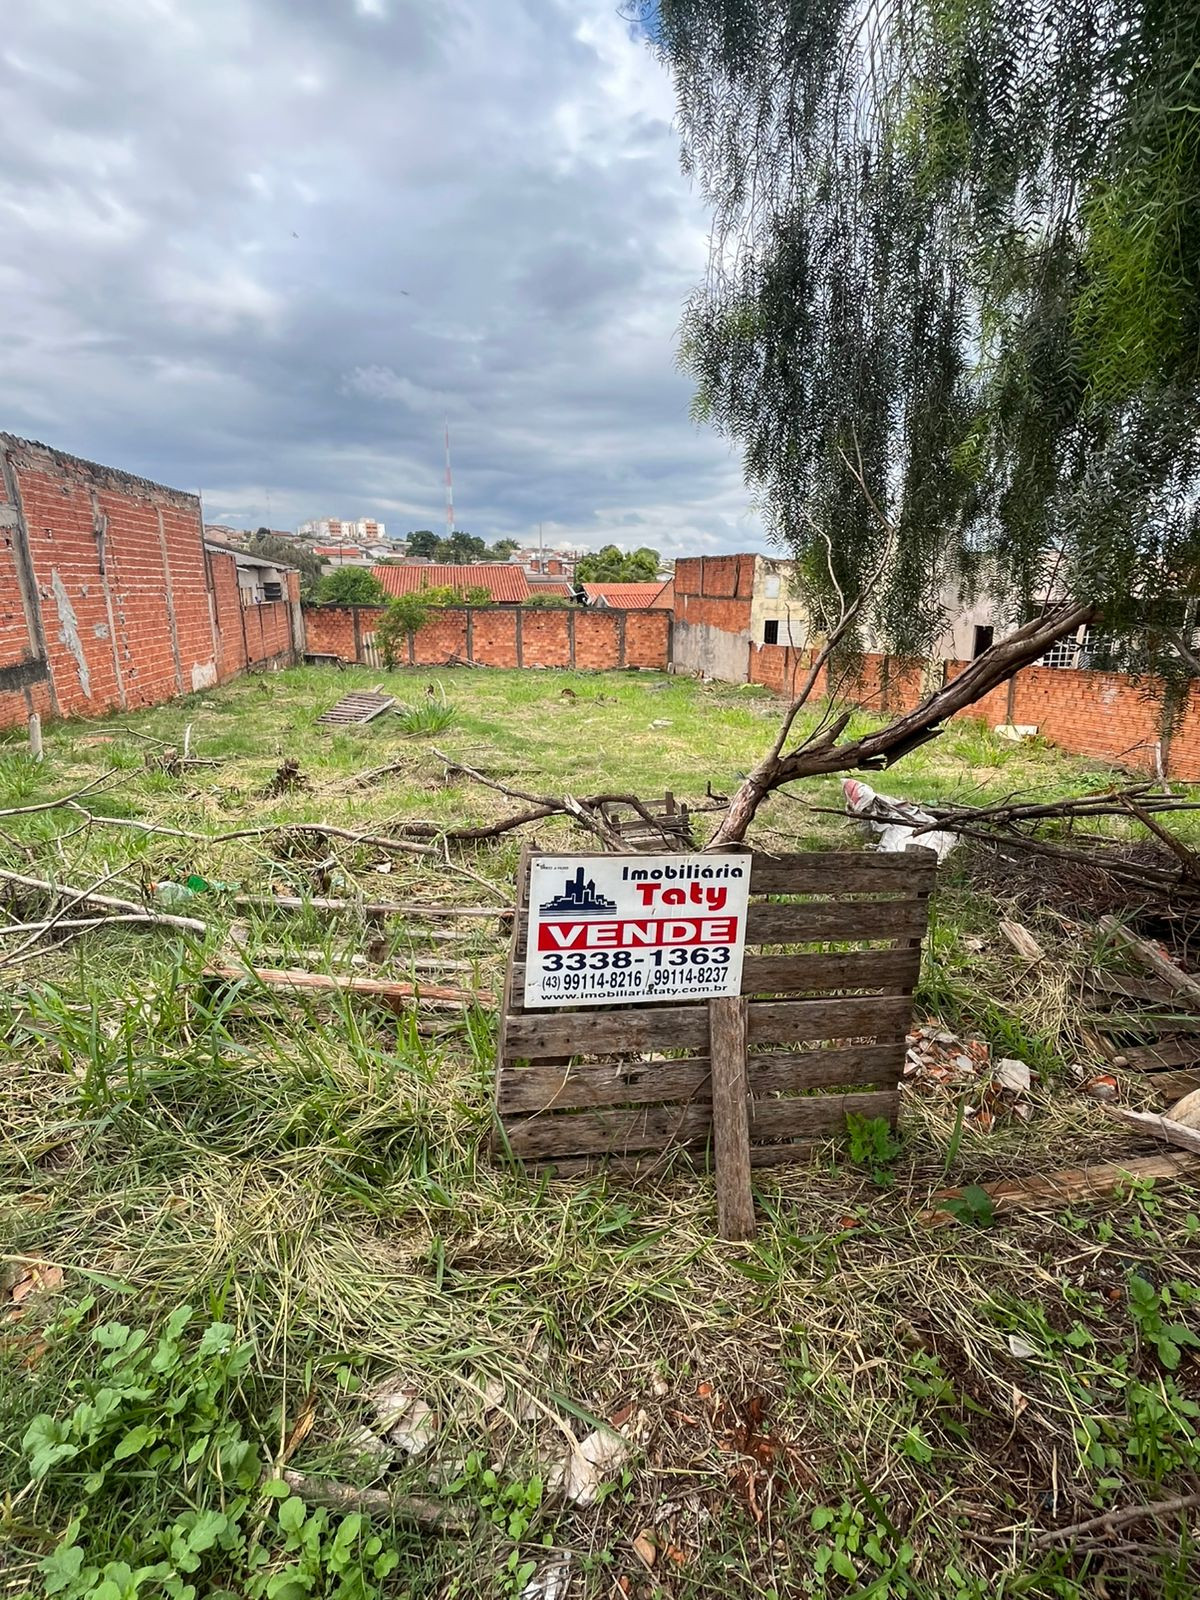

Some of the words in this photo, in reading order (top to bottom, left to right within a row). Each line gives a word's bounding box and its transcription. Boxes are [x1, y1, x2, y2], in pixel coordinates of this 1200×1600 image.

[622, 864, 743, 881] Imobiliária
[636, 882, 728, 911] Taty
[547, 920, 731, 948] VENDE
[542, 947, 731, 972] 3338-1363
[542, 975, 561, 991] (43)
[563, 971, 642, 990] 99114-8216
[654, 967, 729, 986] 99114-8237
